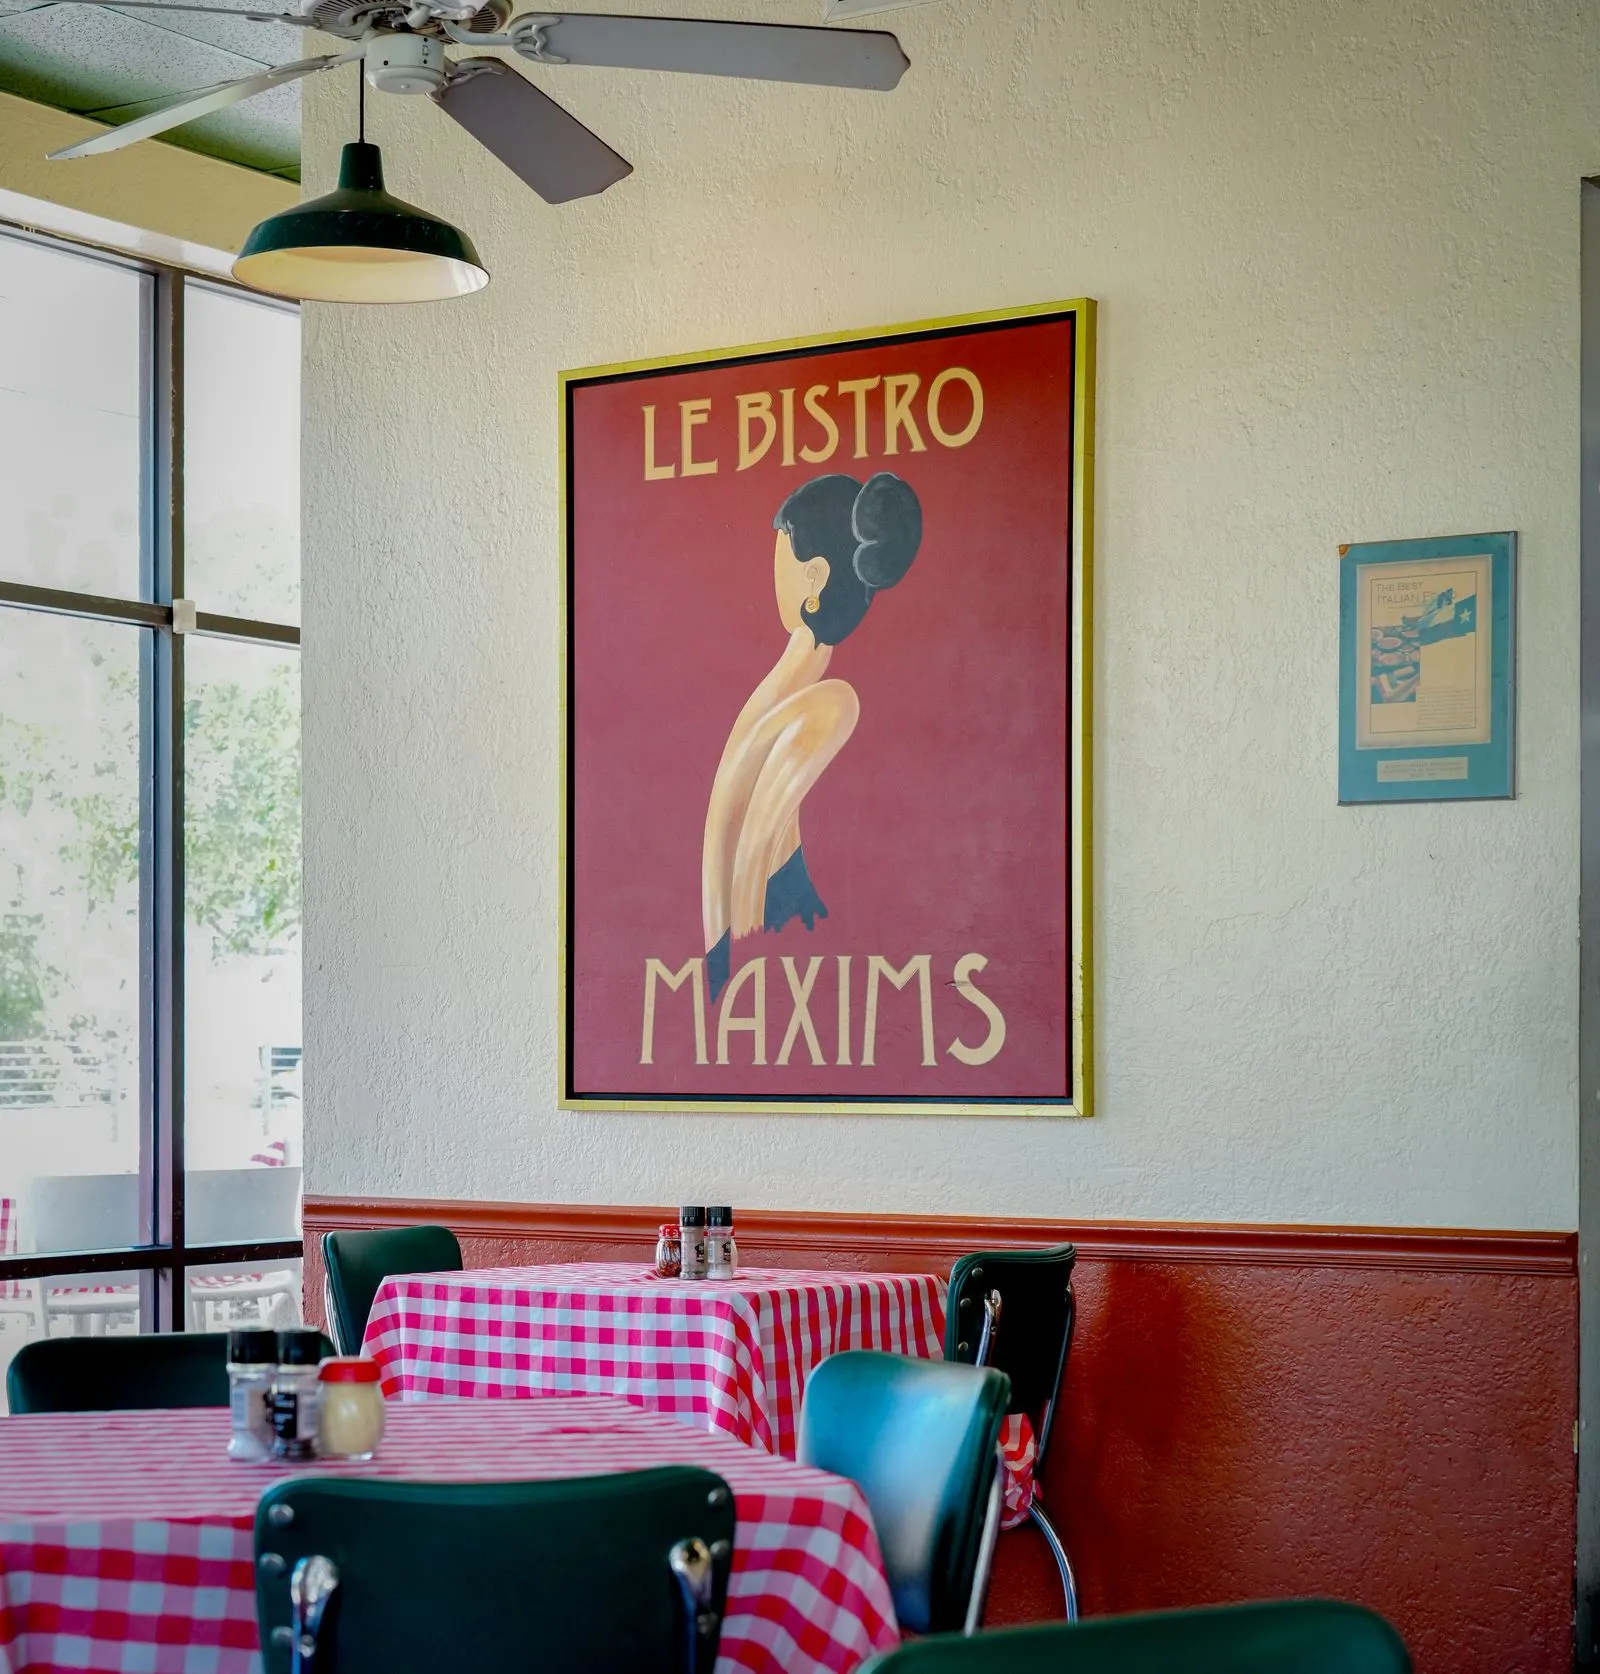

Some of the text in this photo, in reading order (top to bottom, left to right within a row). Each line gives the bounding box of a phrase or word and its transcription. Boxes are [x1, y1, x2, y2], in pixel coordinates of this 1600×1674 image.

[642, 367, 984, 480] LE BISTRO
[1377, 592, 1420, 605] ITALIAN
[639, 952, 1006, 1066] MAXIMS
